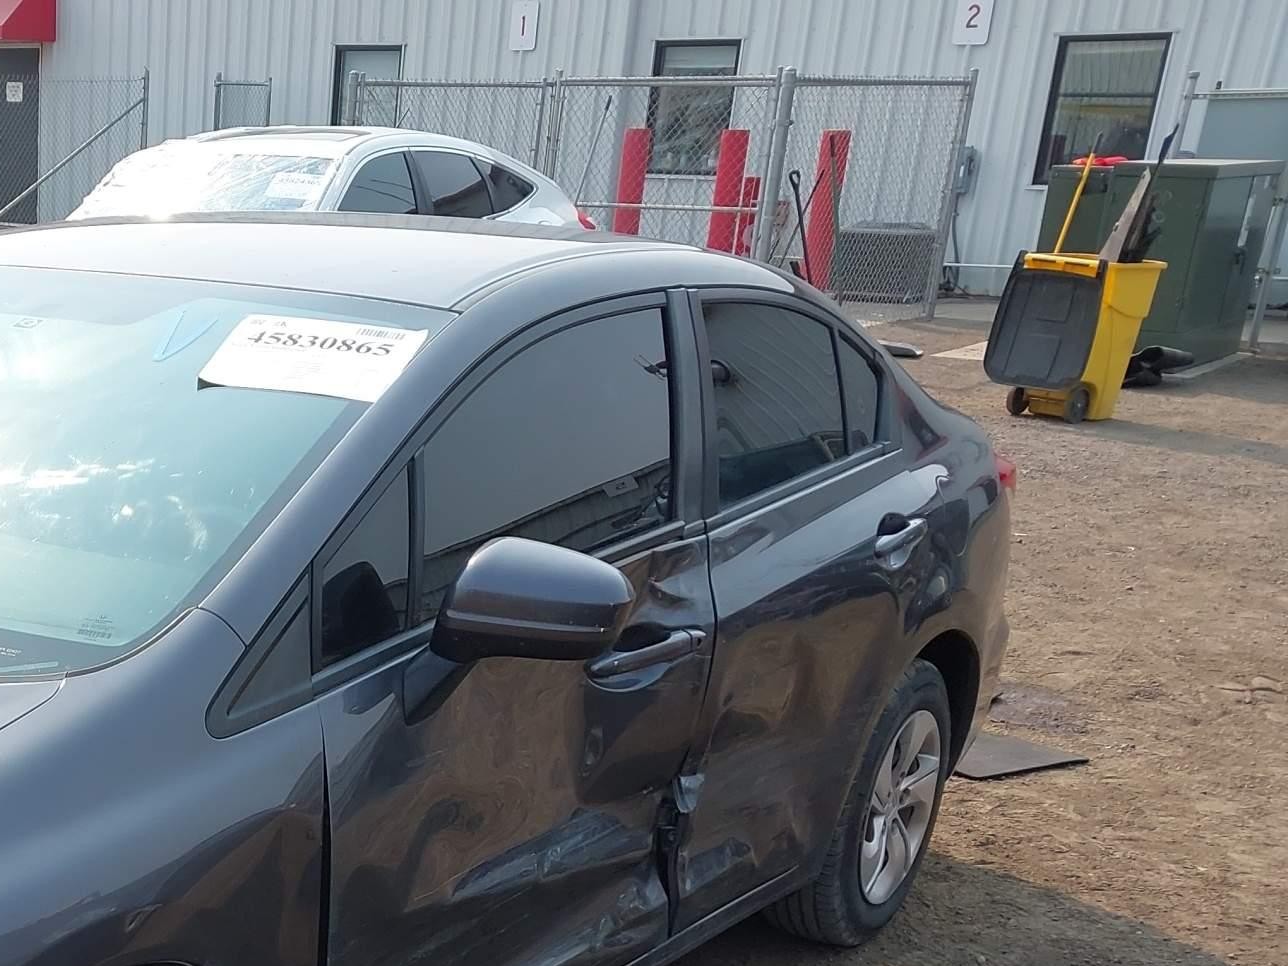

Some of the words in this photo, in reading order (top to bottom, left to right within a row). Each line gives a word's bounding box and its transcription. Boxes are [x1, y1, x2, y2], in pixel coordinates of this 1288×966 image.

[521, 15, 526, 36] 1
[966, 4, 980, 28] 2
[247, 330, 396, 356] 45830865
